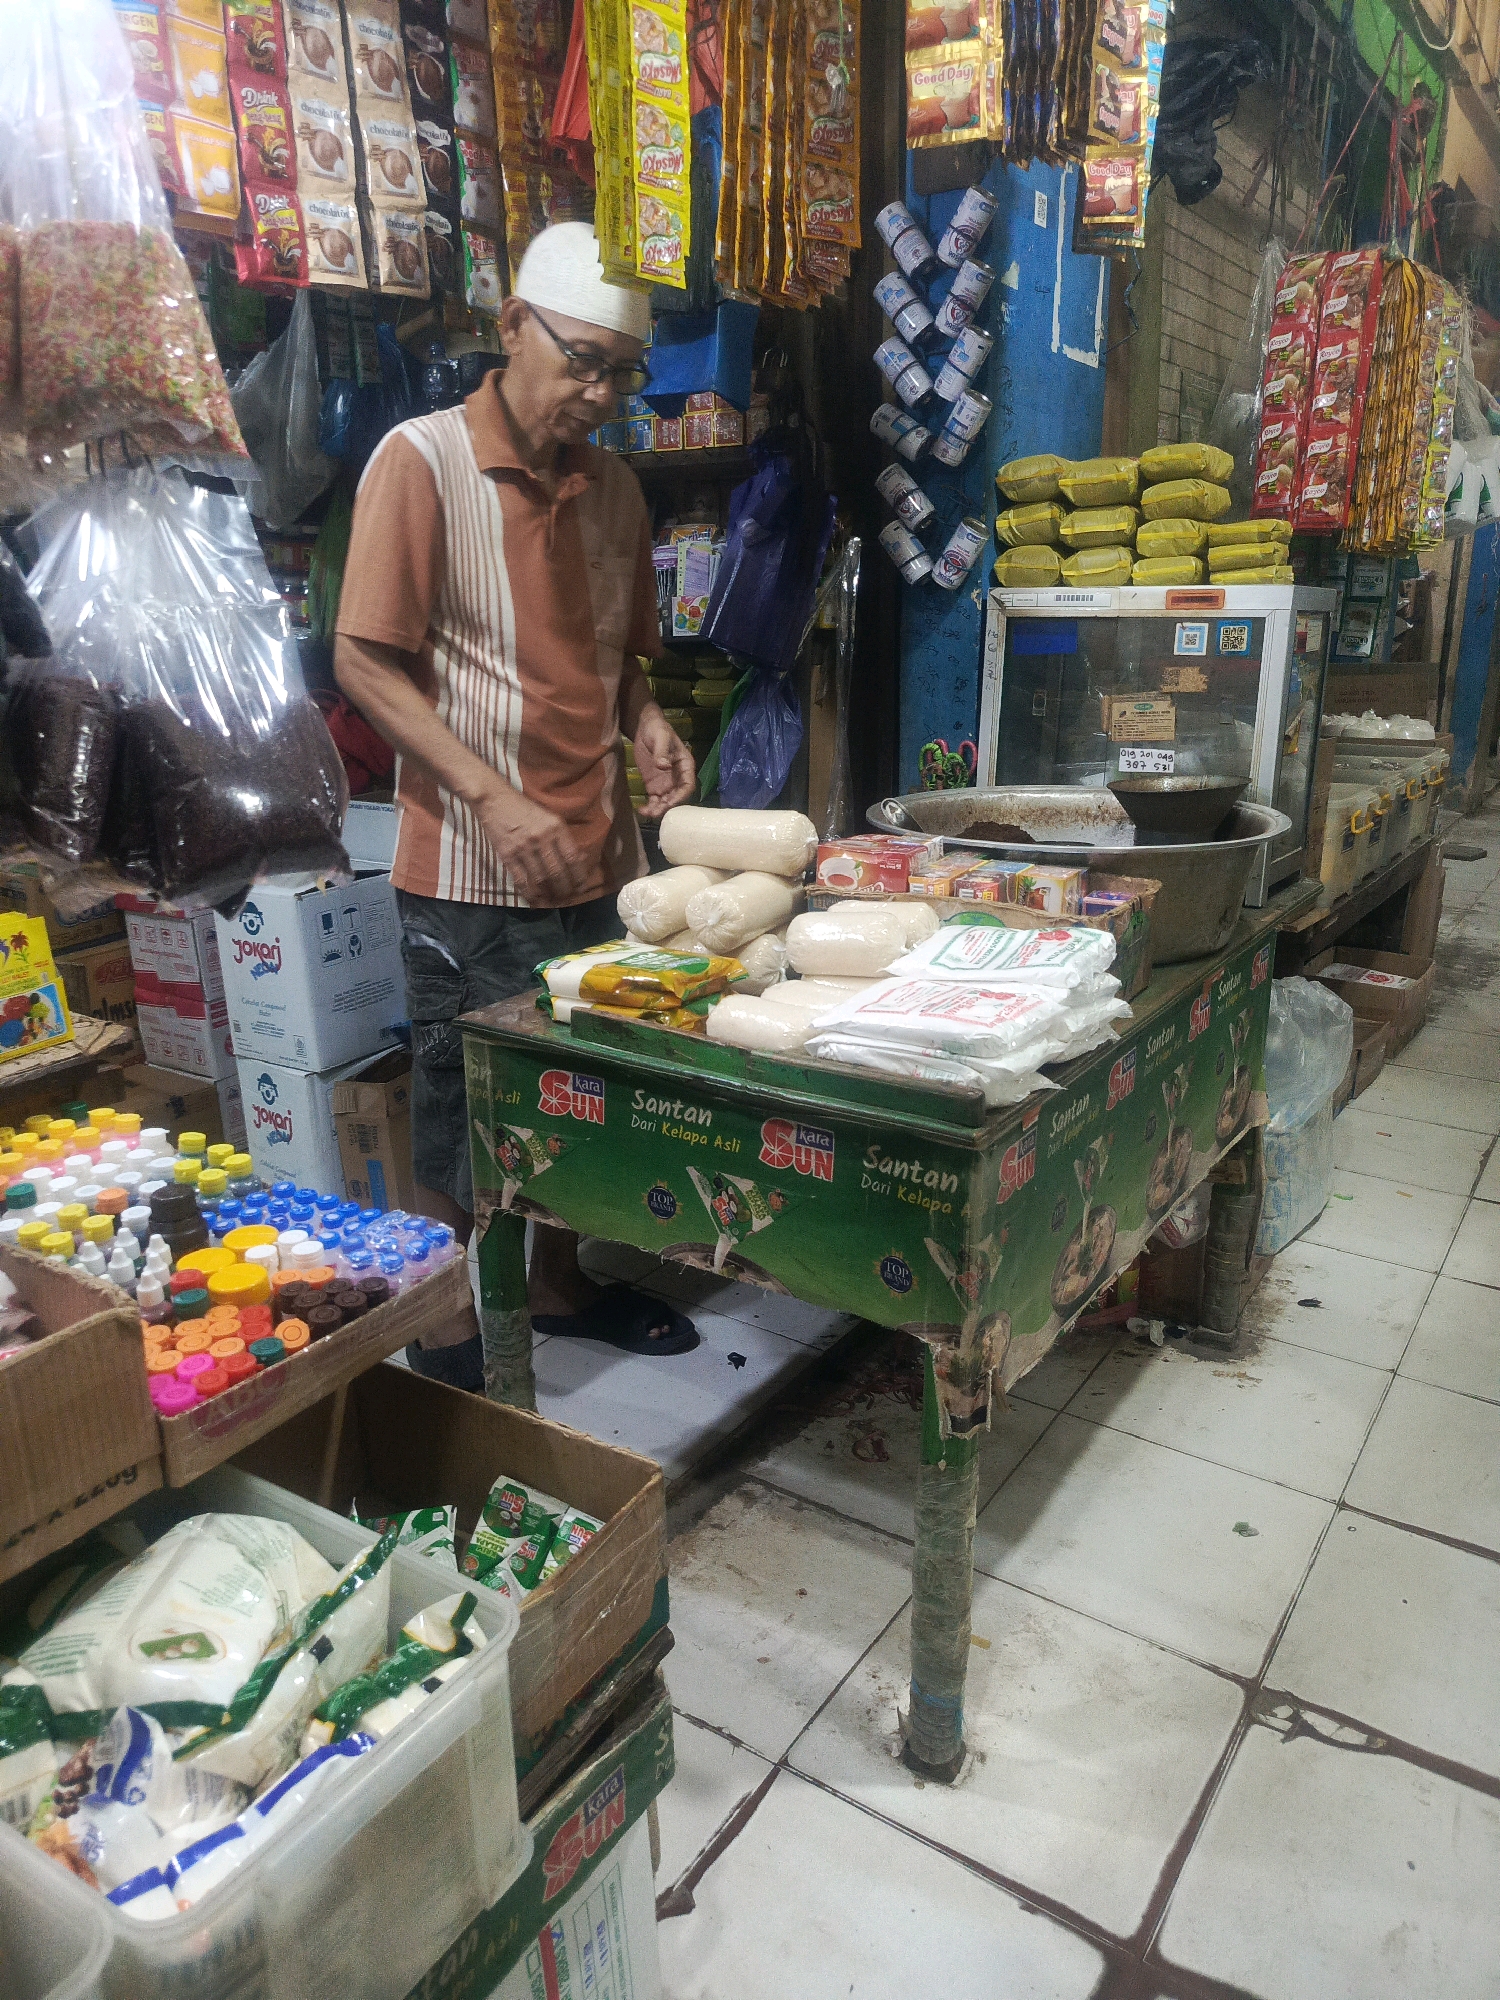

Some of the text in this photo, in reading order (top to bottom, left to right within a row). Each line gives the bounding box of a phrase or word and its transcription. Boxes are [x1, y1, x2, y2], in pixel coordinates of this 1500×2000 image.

[641, 58, 681, 83] Masako
[914, 66, 974, 86] Good Day
[241, 87, 279, 107] Drink
[642, 151, 684, 176] Masako
[1089, 162, 1133, 177] Good Day
[1326, 299, 1347, 312] Royco
[1269, 336, 1291, 350] Royco
[1320, 347, 1341, 361] Royco
[1263, 426, 1281, 439] Royco
[1310, 441, 1332, 455] Royco
[1260, 472, 1278, 485] Royco
[1303, 486, 1325, 500] Royco
[1121, 749, 1136, 760] 019
[1140, 750, 1153, 760] 201
[1154, 762, 1170, 772] 531
[1146, 1023, 1176, 1058] Santan
[575, 1074, 600, 1093] kara
[1105, 1059, 1136, 1112] SUN
[495, 1088, 521, 1105] Asli
[537, 1068, 605, 1126] SUN
[631, 1088, 713, 1128] Santan
[1049, 1093, 1090, 1139] Santan
[630, 1113, 742, 1154] Dari Kelapa Asli
[798, 1126, 831, 1148] kara
[758, 1116, 835, 1183] SUN
[863, 1144, 959, 1194] Santan
[995, 1143, 1037, 1205] SUN
[650, 1192, 674, 1205] TOP
[860, 1172, 953, 1215] Dari Kelapa
[885, 1261, 910, 1278] TOP
[500, 1489, 527, 1514] SUN
[475, 1536, 506, 1554] KELAPA
[587, 1776, 619, 1820] kara
[541, 1790, 626, 1904] SUN
